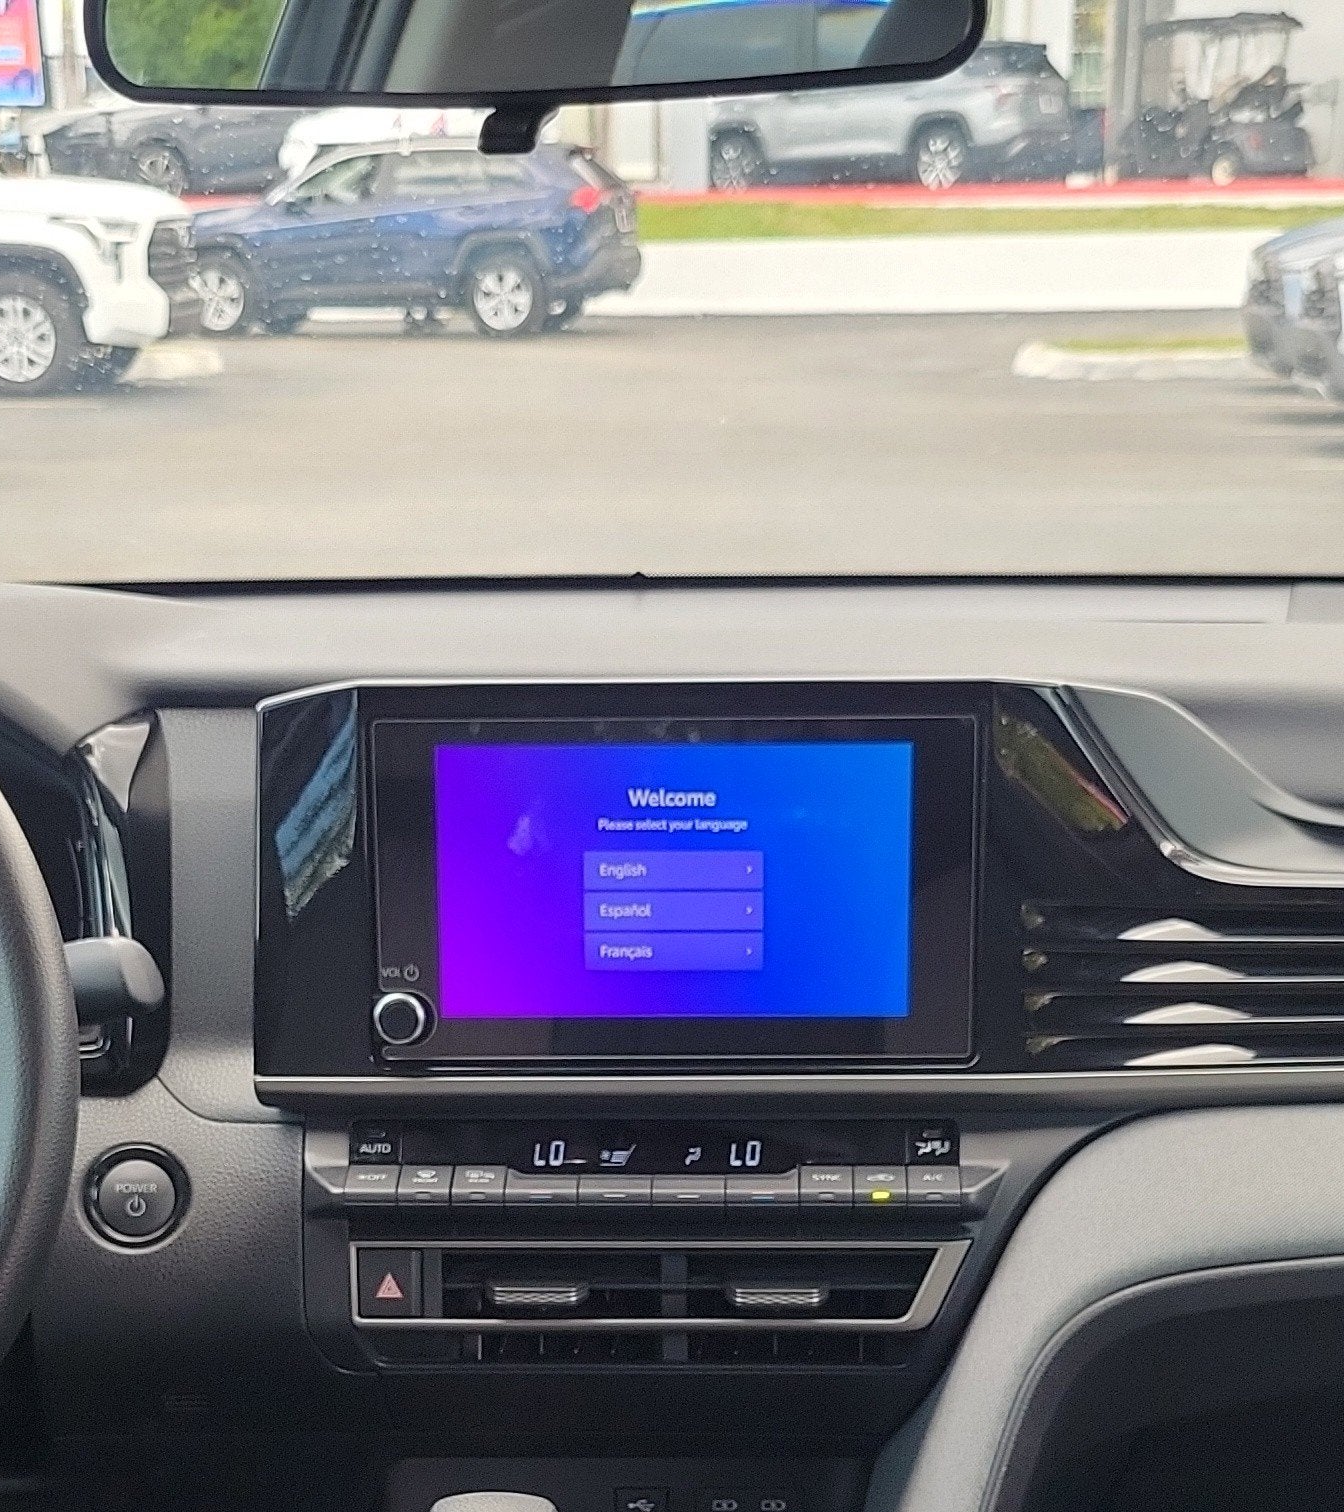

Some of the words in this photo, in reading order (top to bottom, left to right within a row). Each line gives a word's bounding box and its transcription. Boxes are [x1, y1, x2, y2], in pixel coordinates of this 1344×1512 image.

[627, 787, 718, 807] Welcome
[597, 817, 633, 831] Please
[635, 818, 667, 831] select
[668, 820, 693, 833] your
[695, 819, 748, 833] language
[599, 862, 648, 880] English
[599, 902, 652, 921] Español
[599, 944, 654, 961] Français
[359, 1143, 392, 1154] AUTO
[116, 1183, 158, 1194] POWER
